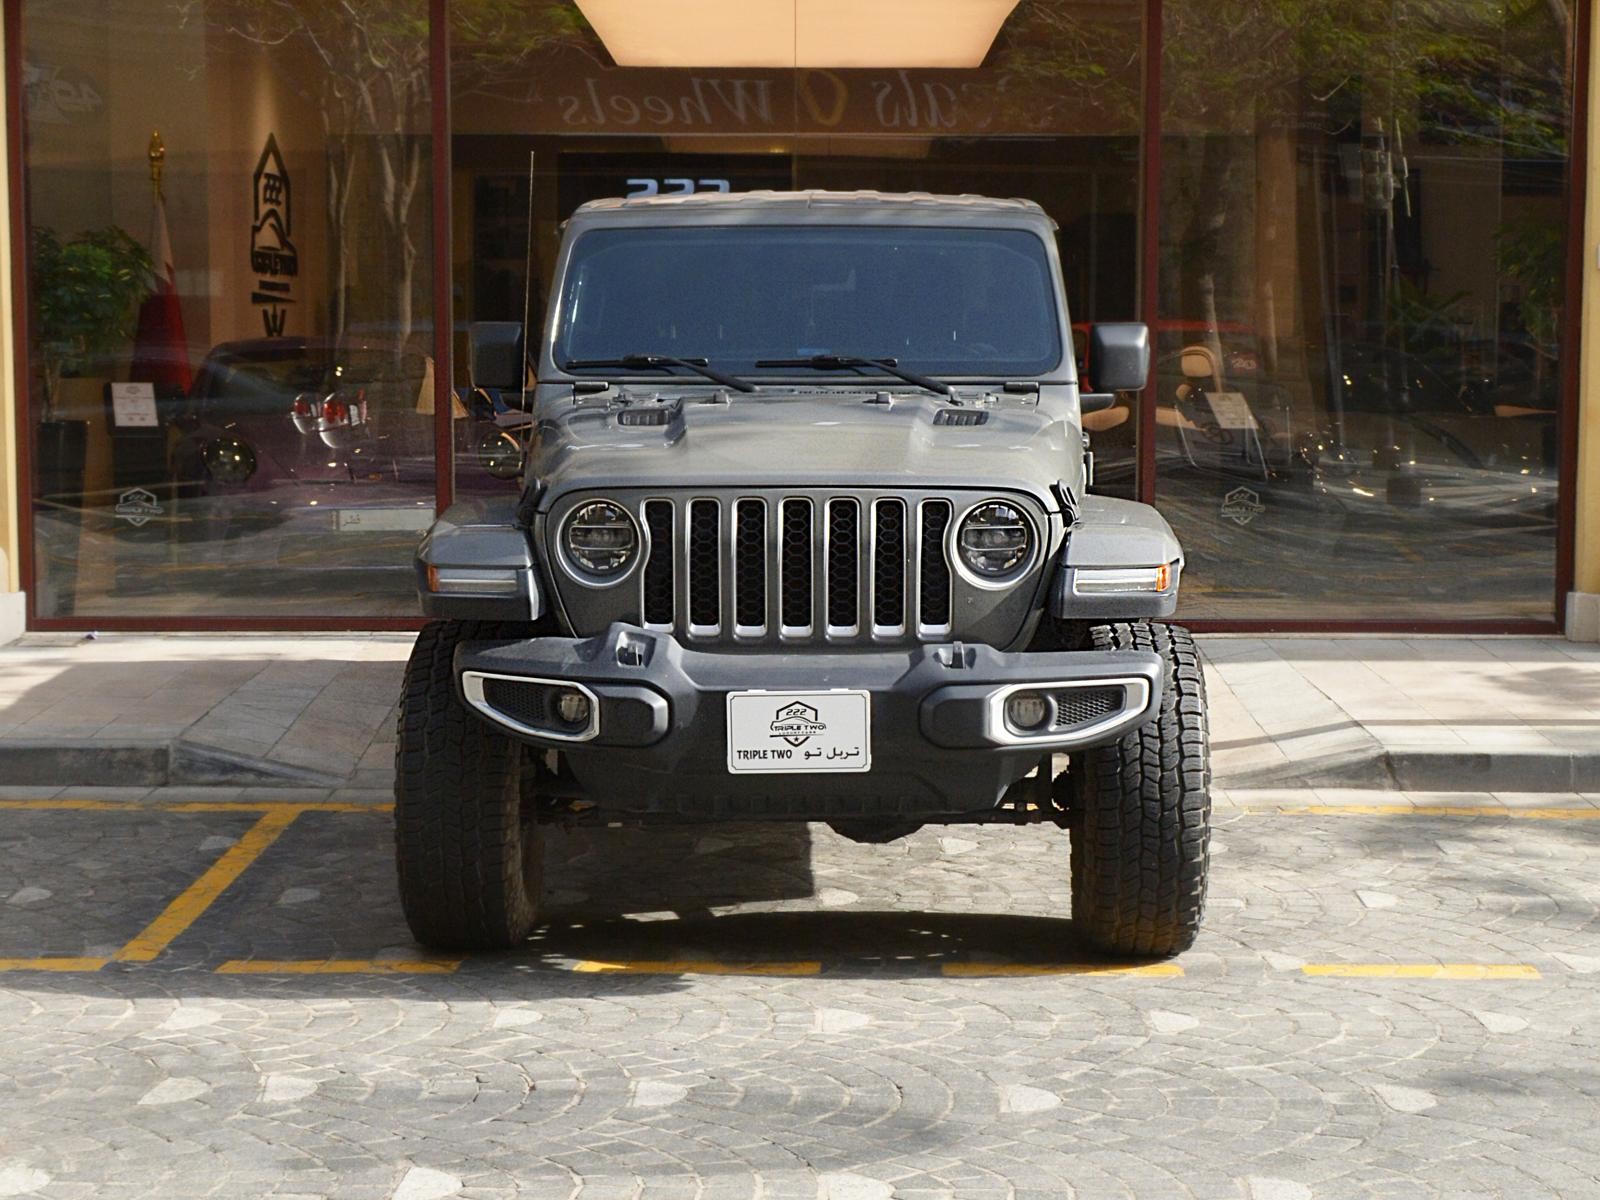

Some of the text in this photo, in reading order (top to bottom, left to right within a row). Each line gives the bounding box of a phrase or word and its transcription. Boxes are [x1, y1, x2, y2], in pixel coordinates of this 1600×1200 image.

[786, 708, 807, 716] 222
[737, 749, 793, 760] TRIPLE TWO
